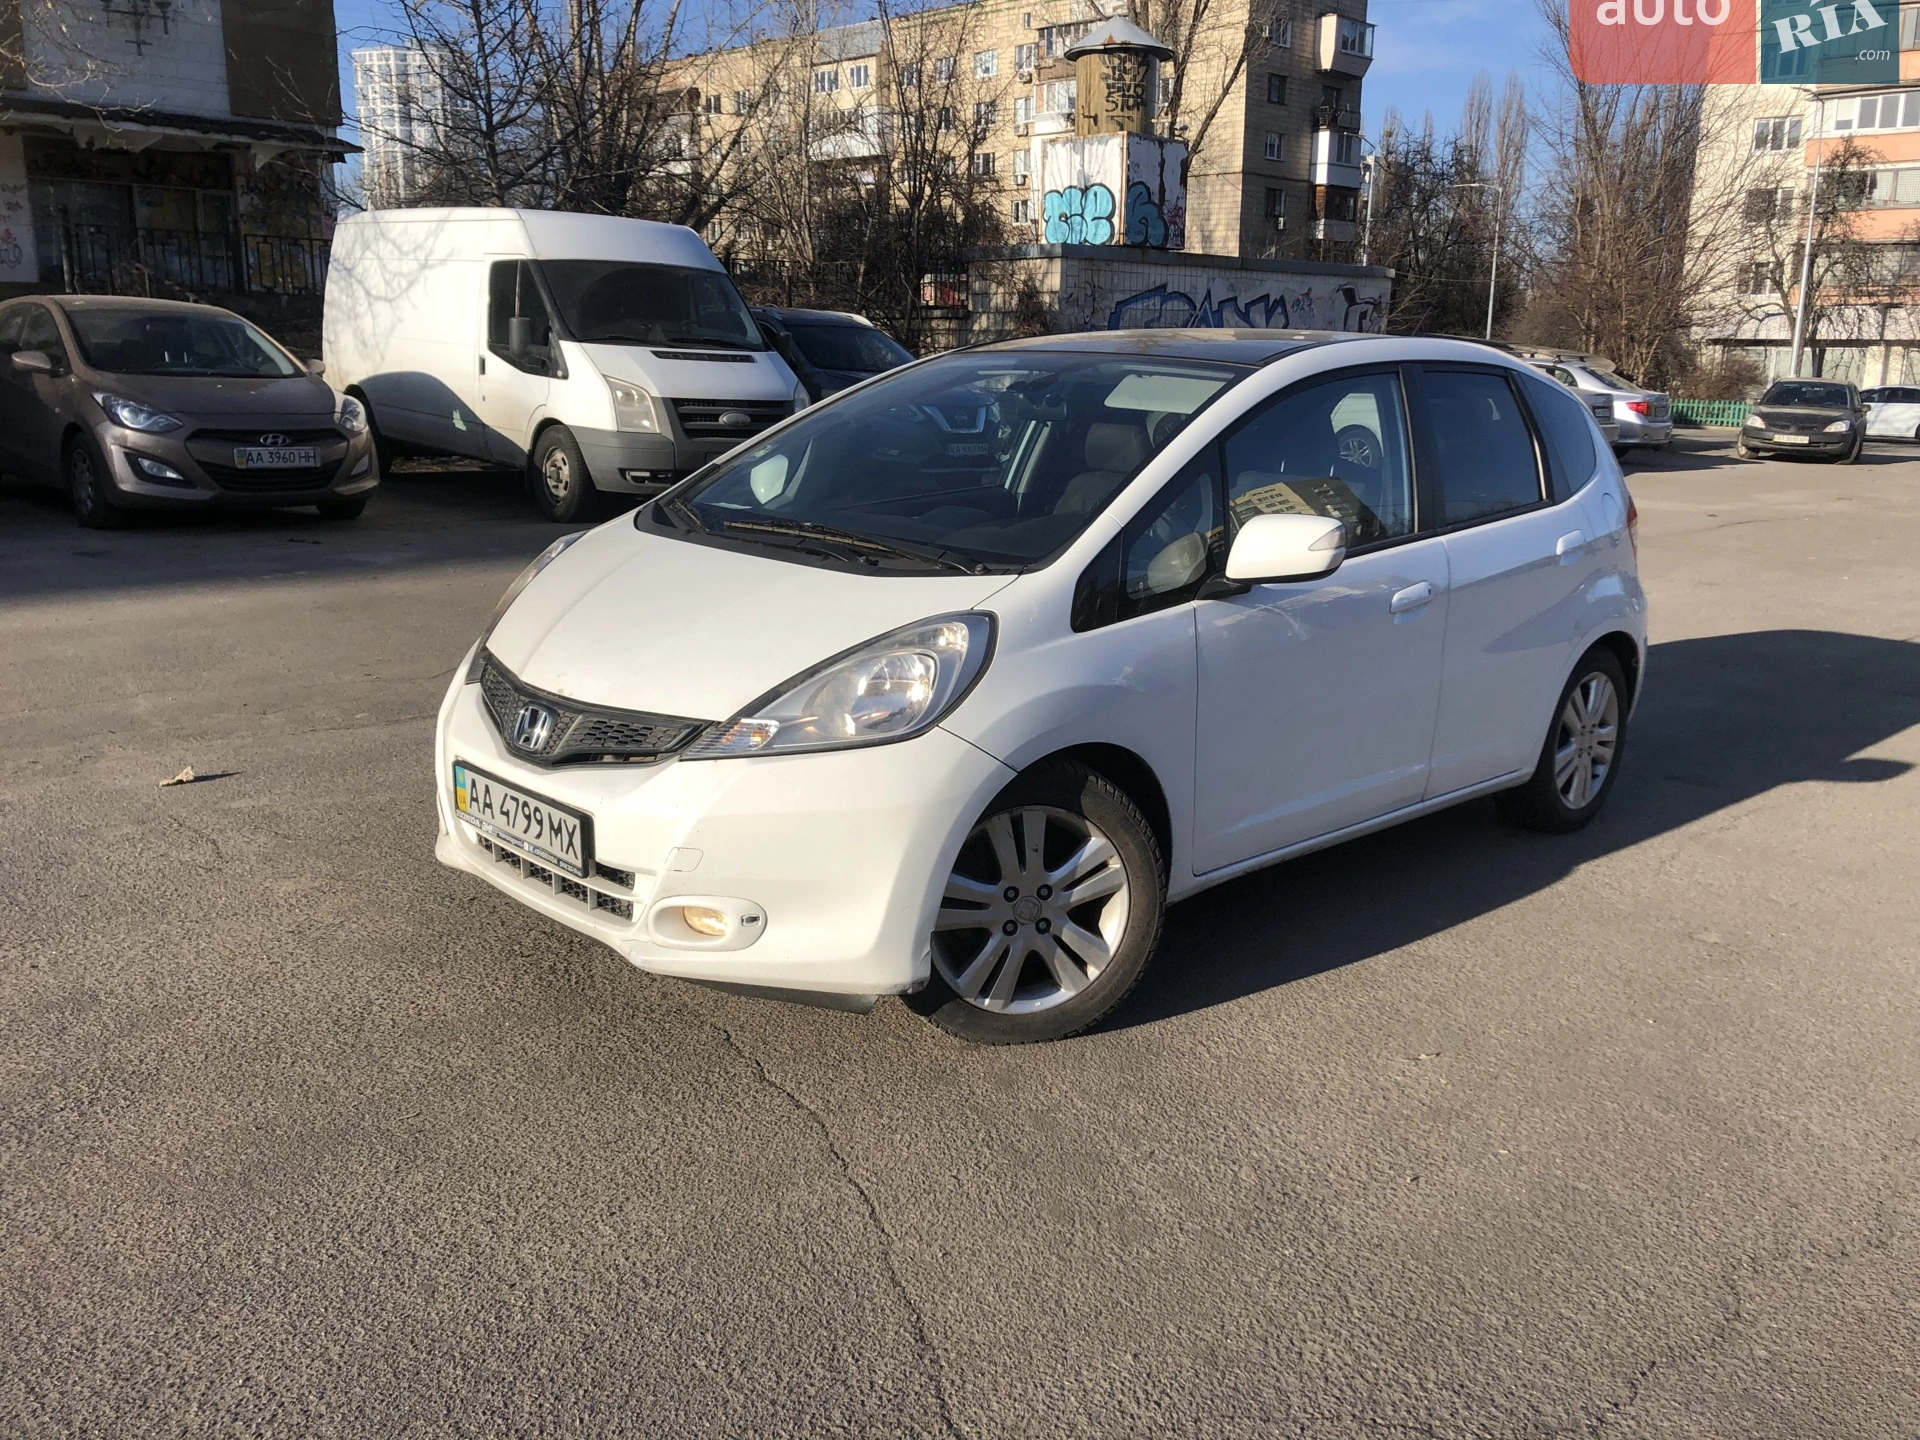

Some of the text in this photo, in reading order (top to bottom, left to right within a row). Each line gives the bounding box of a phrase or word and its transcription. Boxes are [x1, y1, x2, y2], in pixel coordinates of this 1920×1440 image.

[246, 451, 316, 464] AA 3960 HH
[469, 777, 495, 820] AA
[500, 792, 544, 840] 4799
[548, 811, 579, 861] MX
